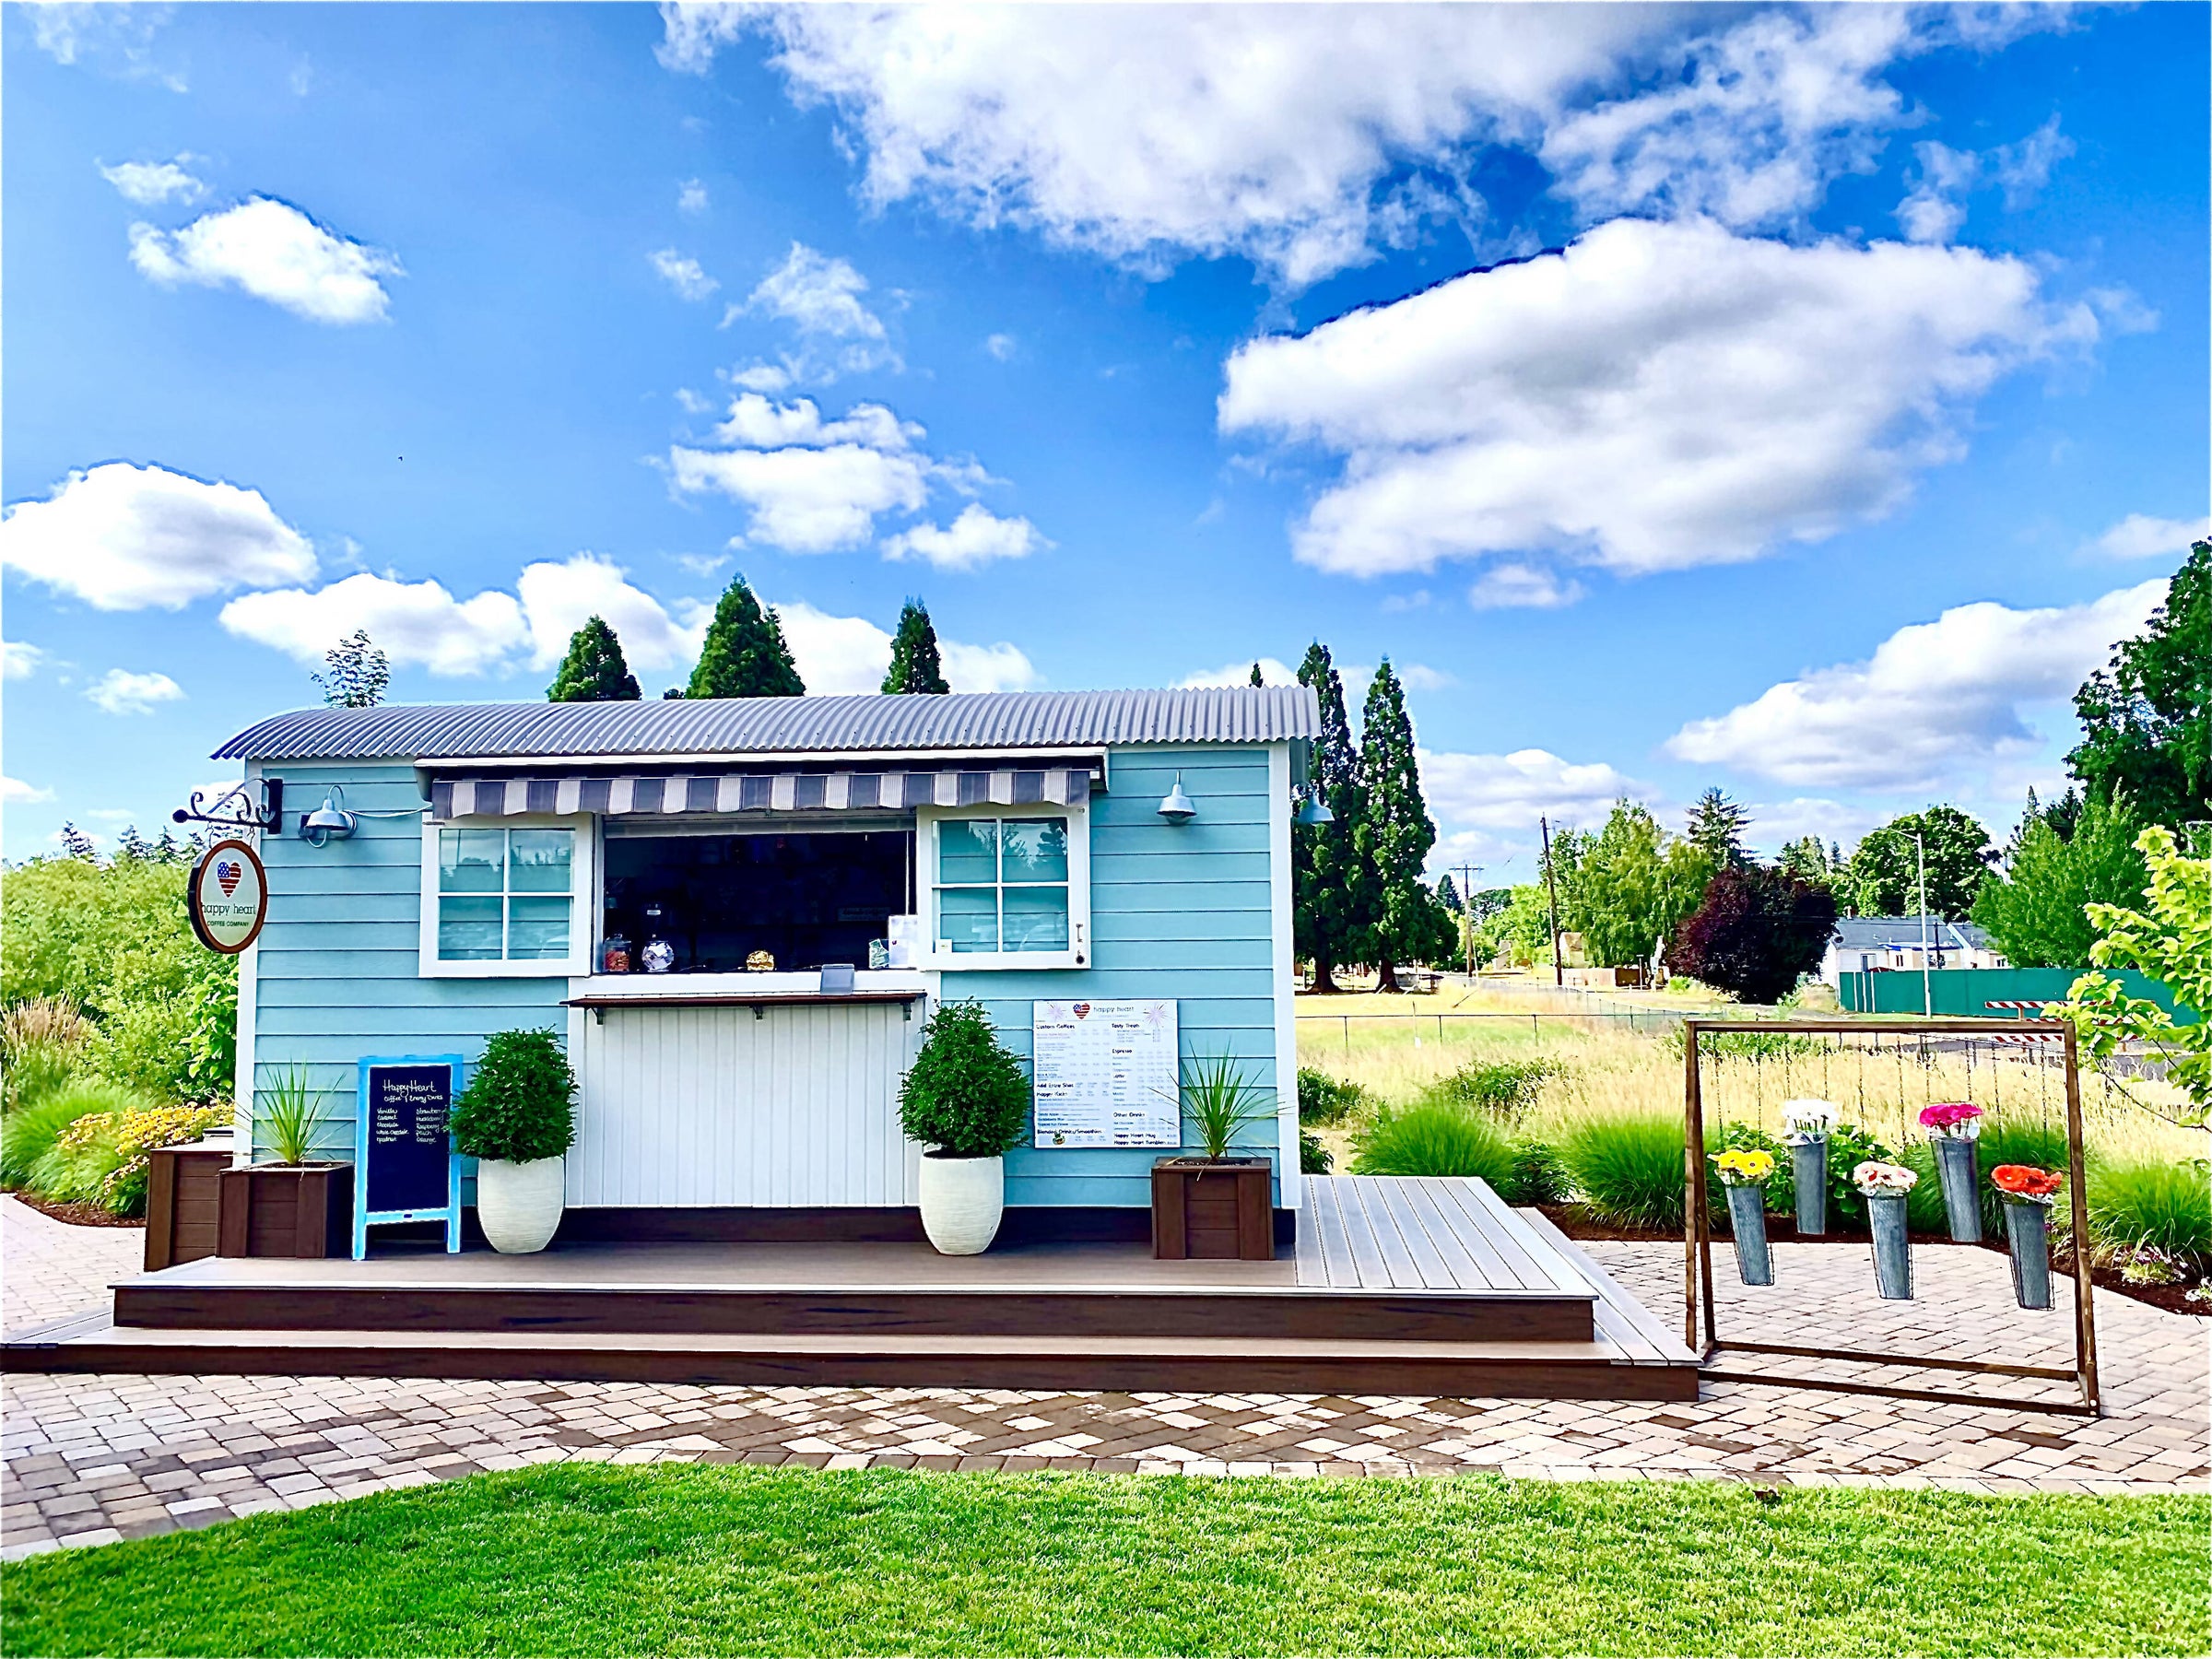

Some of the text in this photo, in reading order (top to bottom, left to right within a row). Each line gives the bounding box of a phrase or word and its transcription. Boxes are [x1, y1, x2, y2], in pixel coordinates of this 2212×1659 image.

[200, 903, 256, 916] happy heart
[382, 1079, 437, 1098] Happy Heart
